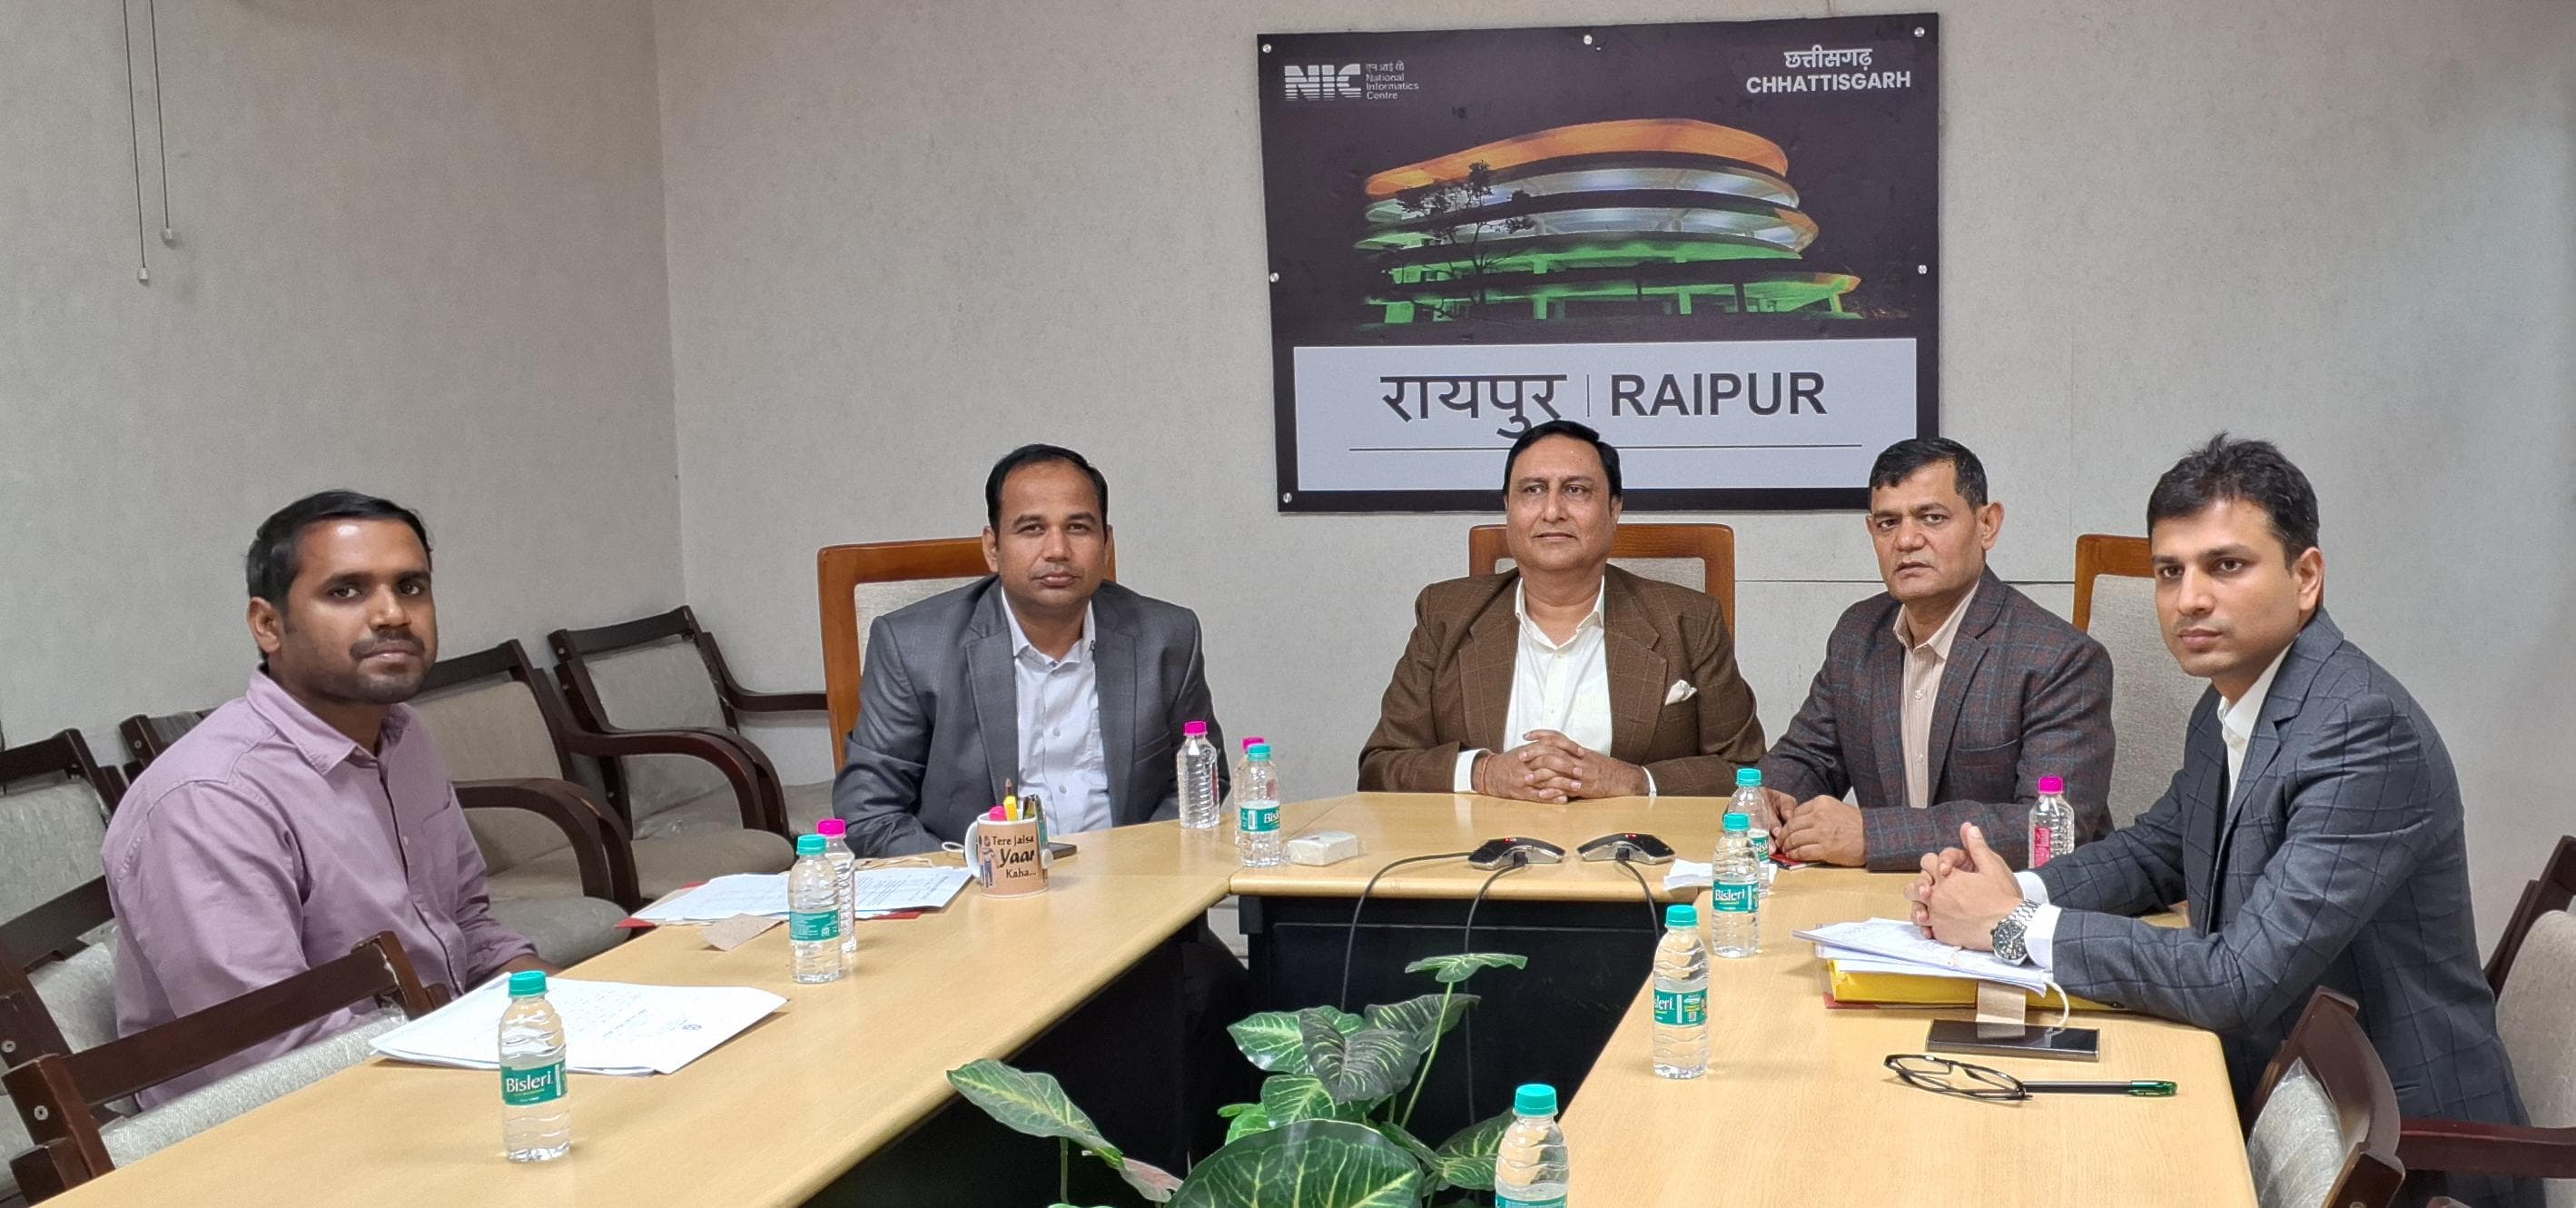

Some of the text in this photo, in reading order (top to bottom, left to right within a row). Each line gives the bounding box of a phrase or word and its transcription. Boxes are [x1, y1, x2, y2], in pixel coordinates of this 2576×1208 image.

[1783, 45, 1873, 71] छत्तीसगढ़
[1284, 63, 1362, 101] NIC
[1366, 73, 1405, 82] National
[1746, 71, 1911, 94] CHHATTISGARH
[1367, 92, 1398, 100] Centre
[1610, 371, 1828, 417] RAIPUR
[1380, 374, 1567, 440] रायपुर
[992, 836, 1012, 846] Tere
[997, 848, 1034, 869] Yaar
[1714, 888, 1745, 901] Bisleri
[506, 1070, 551, 1093] Bisleri
